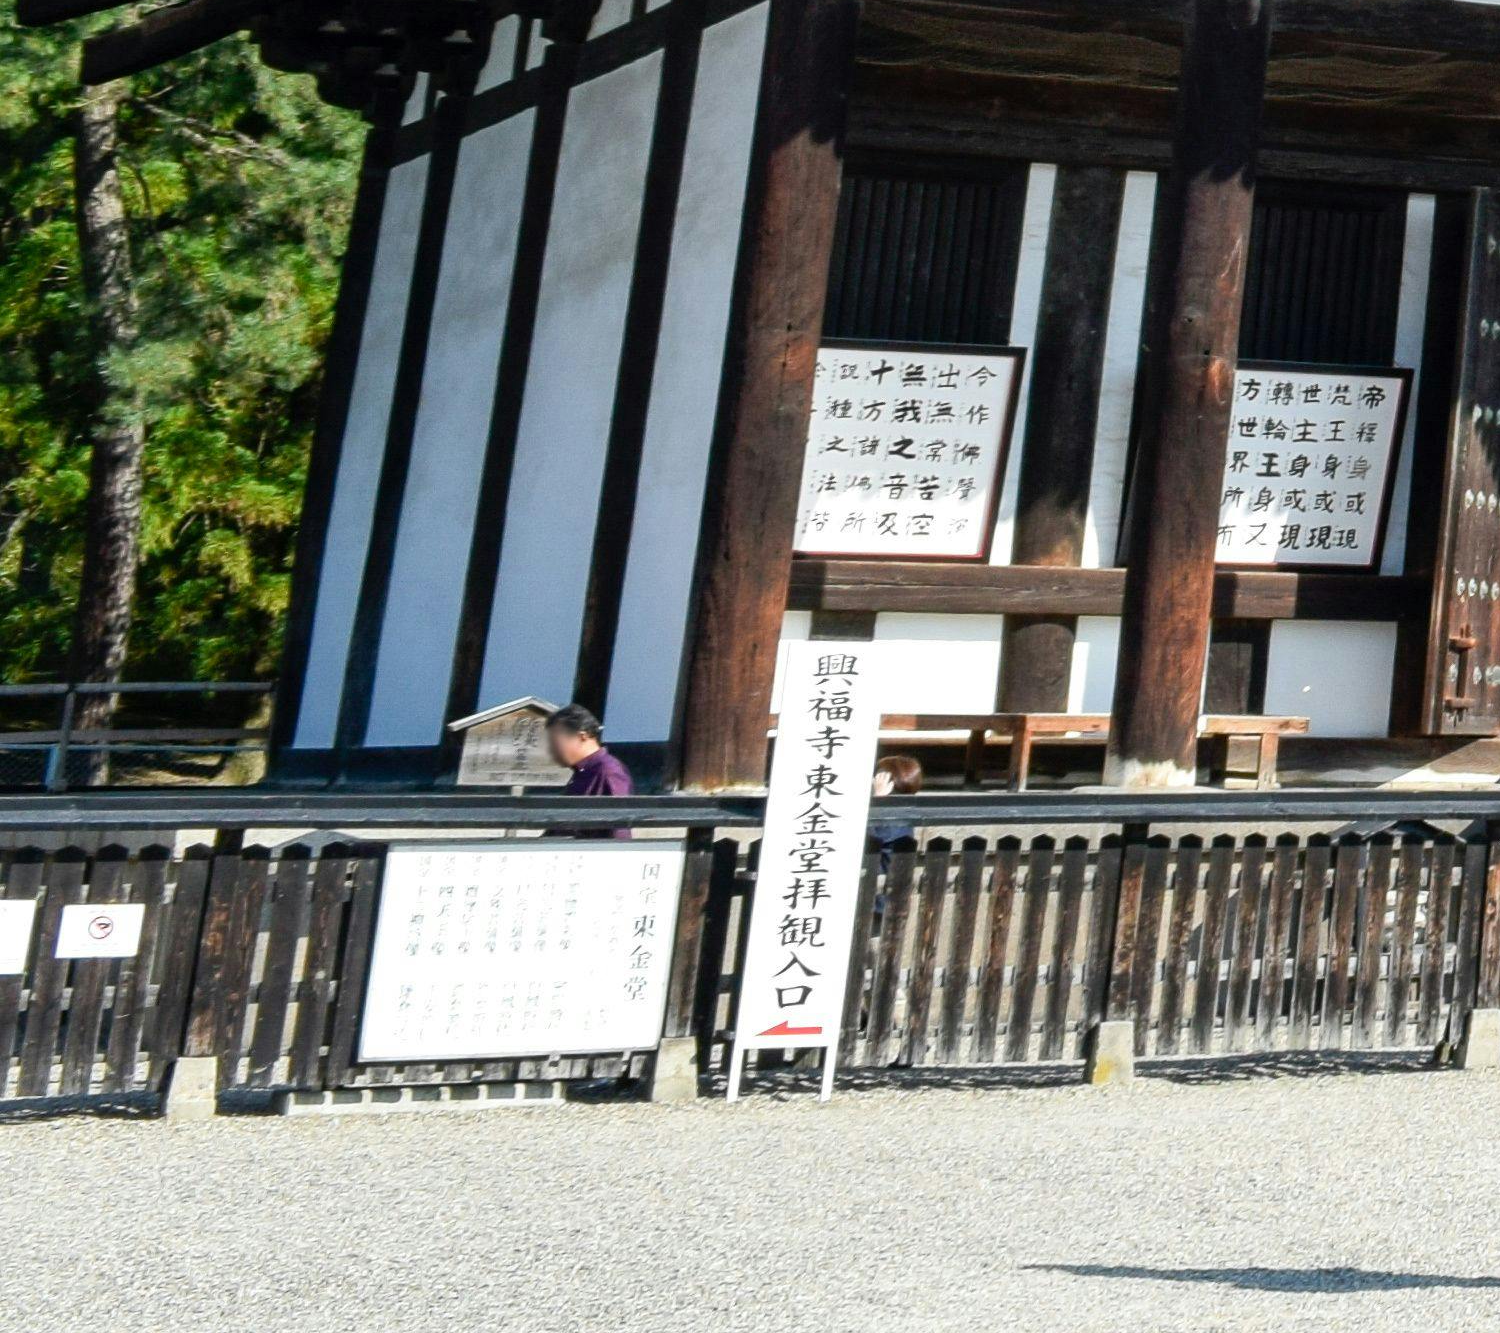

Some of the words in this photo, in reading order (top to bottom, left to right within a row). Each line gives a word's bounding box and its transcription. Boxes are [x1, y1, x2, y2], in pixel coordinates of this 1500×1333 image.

[773, 652, 859, 1009] 興福寺東金堂拝観入口
